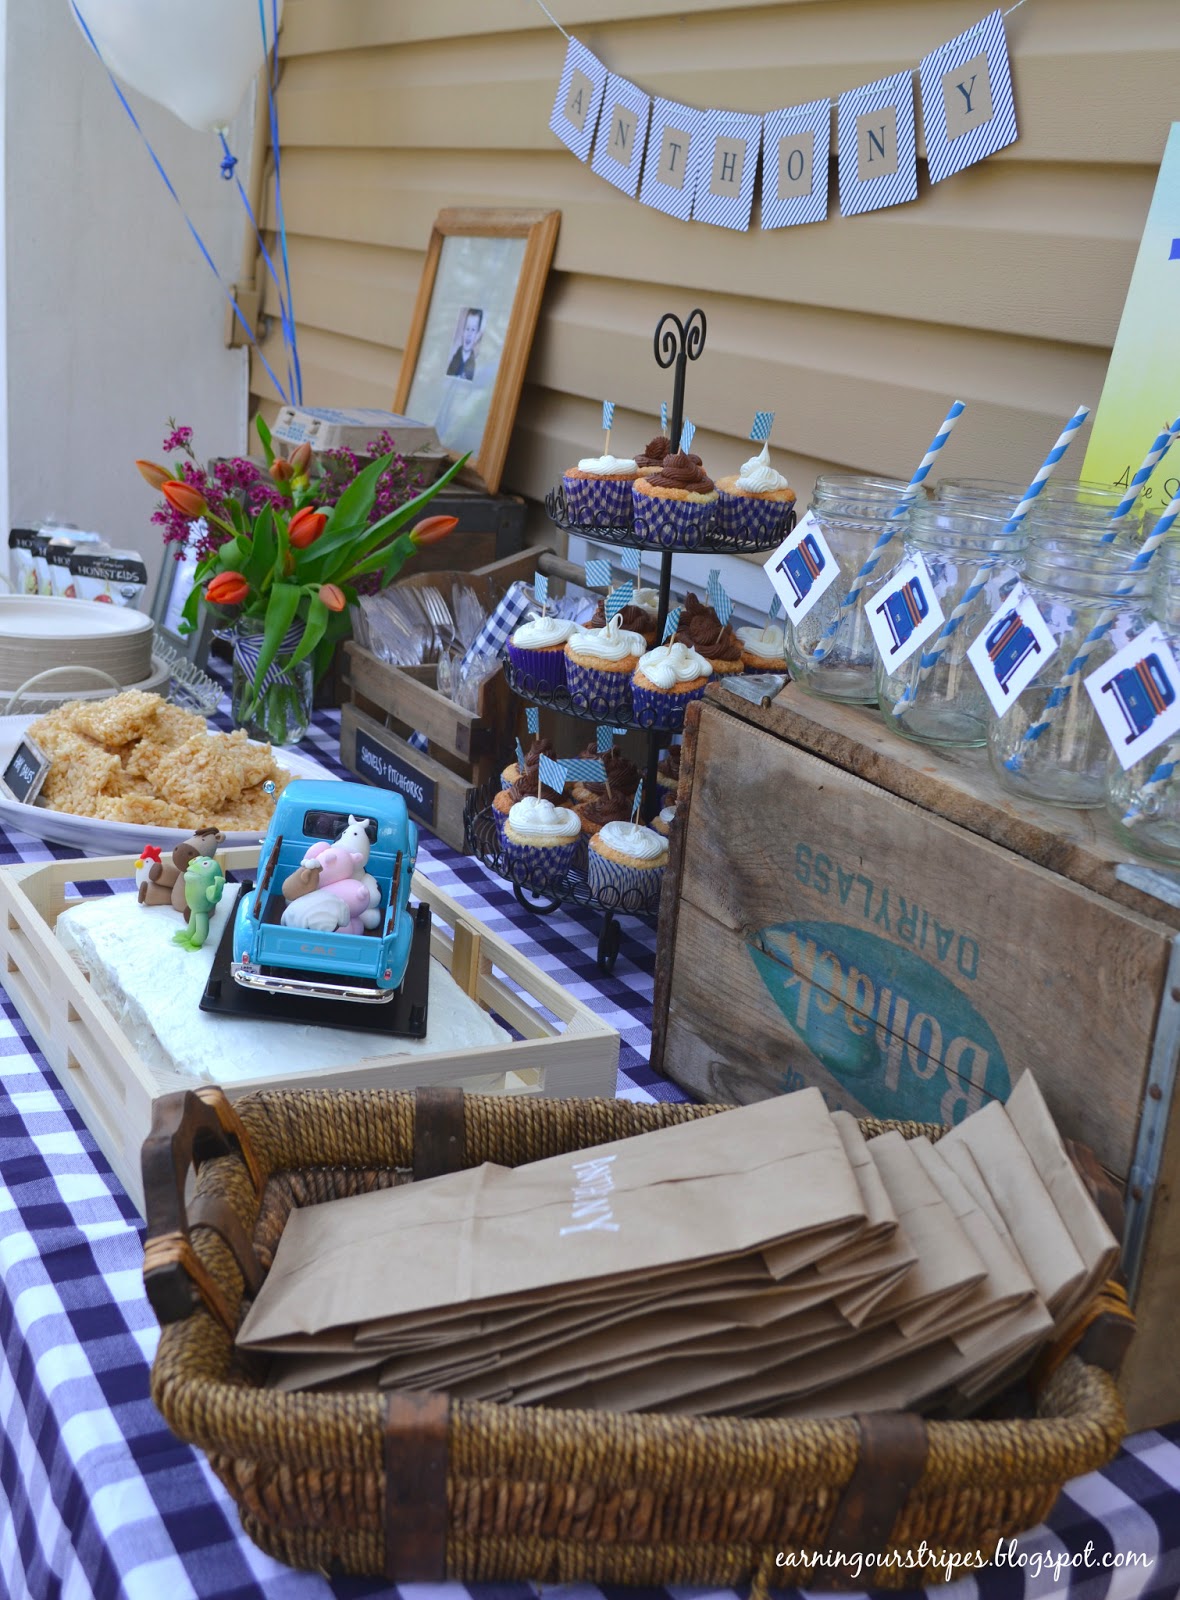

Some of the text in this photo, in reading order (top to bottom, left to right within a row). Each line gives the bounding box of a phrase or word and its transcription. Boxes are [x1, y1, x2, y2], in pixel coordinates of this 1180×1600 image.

[571, 75, 979, 183] ANTHONY
[361, 746, 383, 776] SHOVELS
[387, 764, 424, 803] PITCHFORKS
[793, 842, 980, 981] DAIRYLASS
[783, 930, 991, 1125] Bohack
